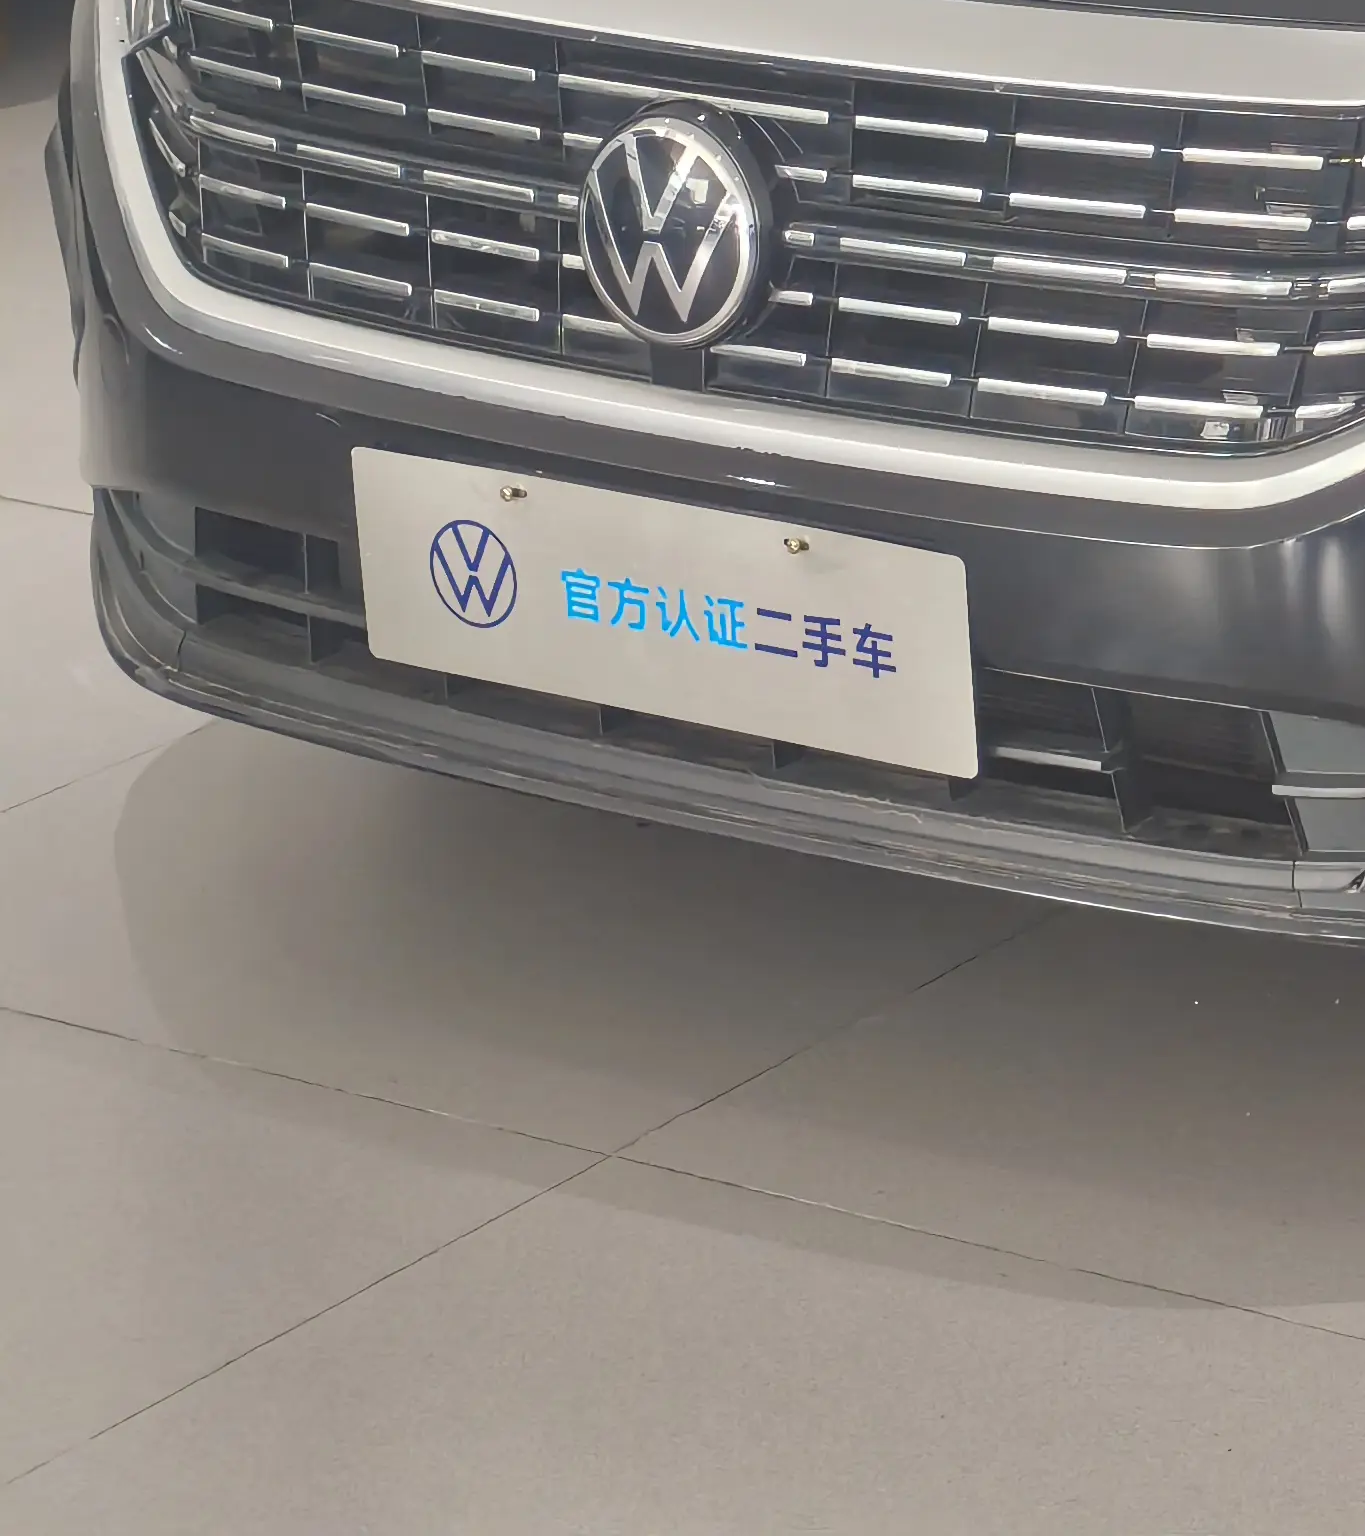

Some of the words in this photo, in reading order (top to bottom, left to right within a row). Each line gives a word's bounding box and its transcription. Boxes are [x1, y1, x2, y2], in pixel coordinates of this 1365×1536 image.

[560, 568, 897, 679] 官方认证二手车
